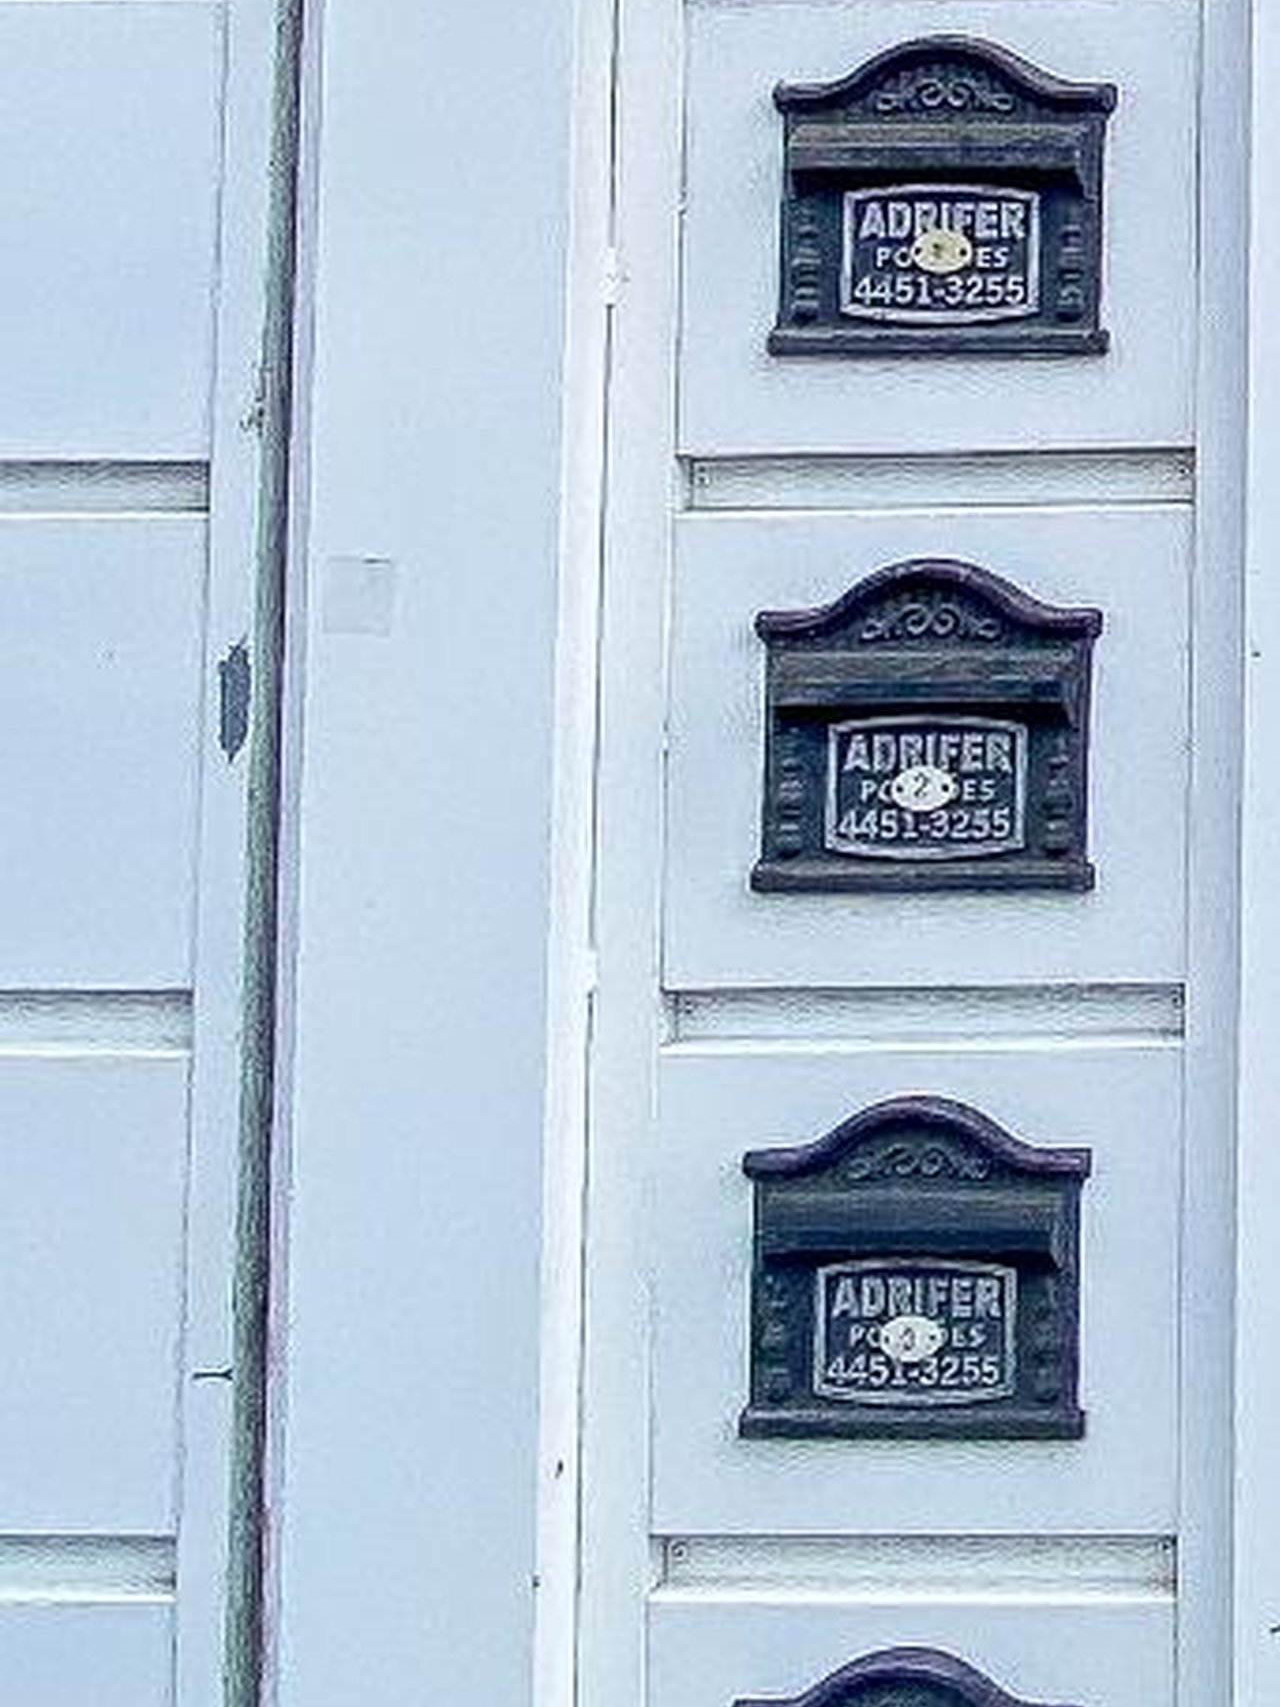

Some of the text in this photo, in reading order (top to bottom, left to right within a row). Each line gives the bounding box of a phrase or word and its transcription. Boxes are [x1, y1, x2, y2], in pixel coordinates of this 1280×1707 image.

[858, 201, 1026, 239] ADRIFER
[854, 275, 1025, 305] 4451-3255
[842, 733, 1013, 773] ADRIFER
[838, 807, 1011, 838] 4451-3255
[831, 1276, 1001, 1317] ADRIFER
[828, 1355, 1000, 1385] 4451-3255
